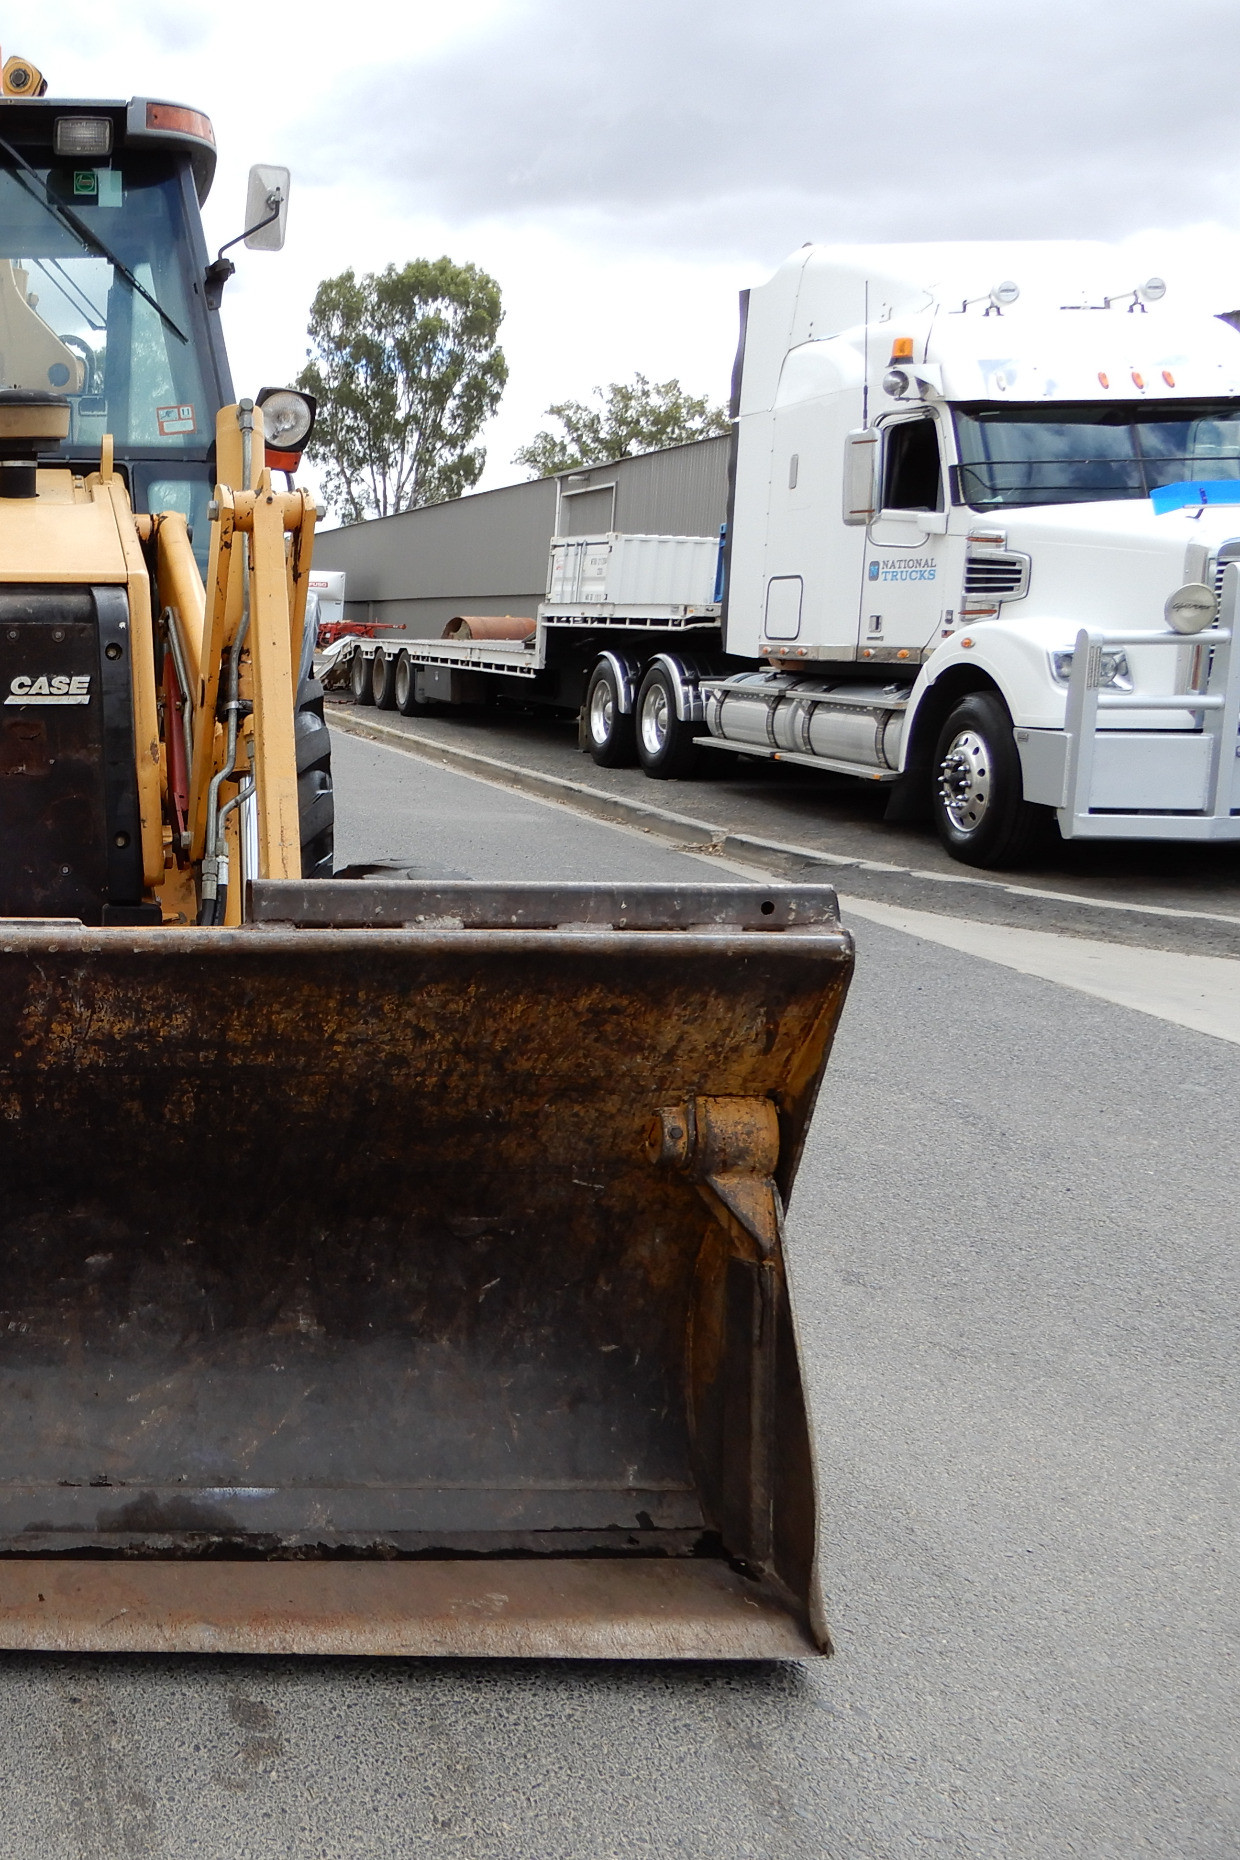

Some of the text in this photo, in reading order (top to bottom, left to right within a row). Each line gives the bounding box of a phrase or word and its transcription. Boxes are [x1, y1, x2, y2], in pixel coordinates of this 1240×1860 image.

[882, 558, 936, 569] NATIONAL
[881, 569, 936, 581] TRUCKS
[10, 676, 90, 695] CASE
